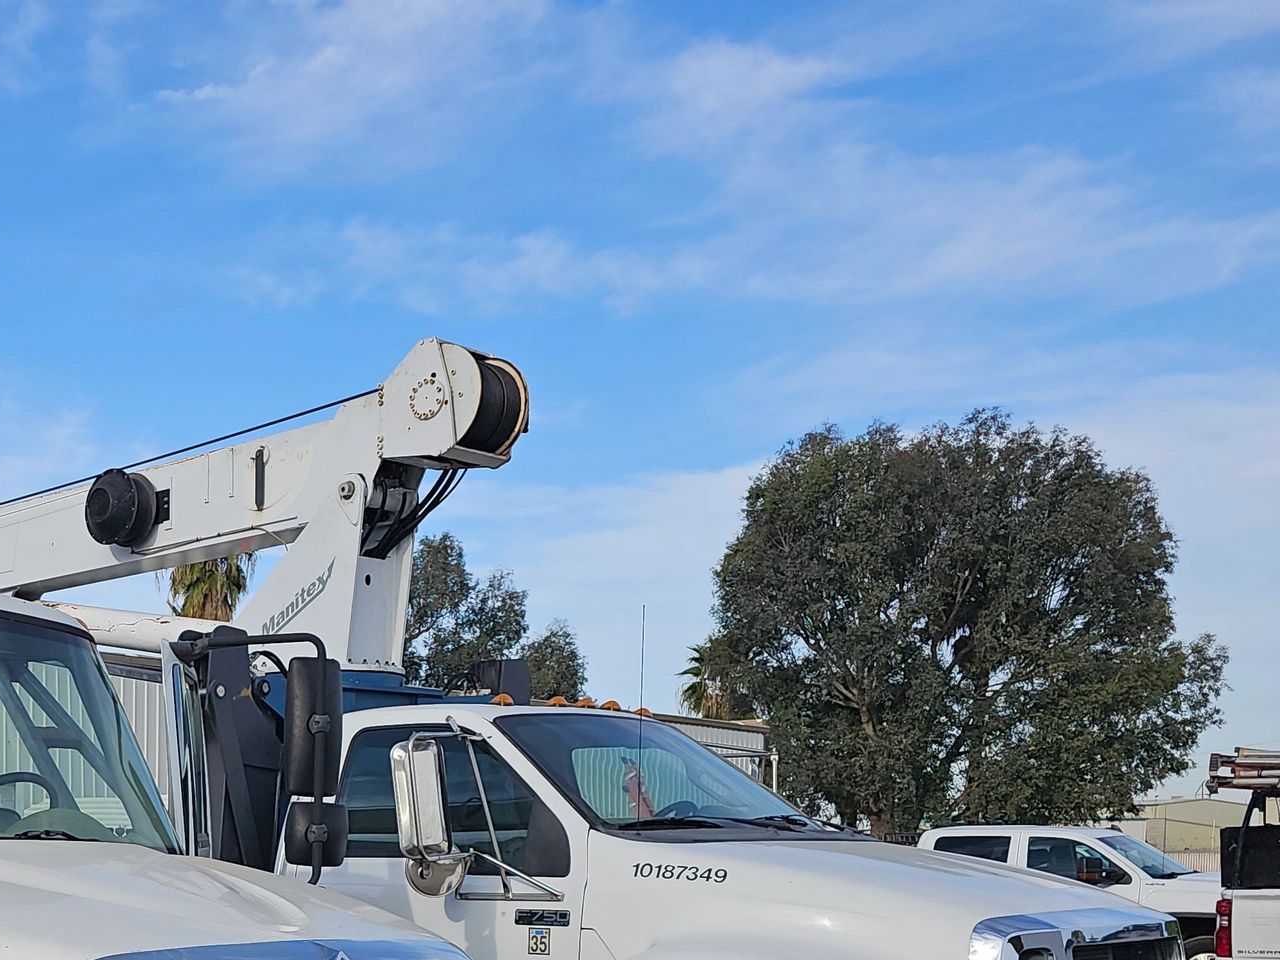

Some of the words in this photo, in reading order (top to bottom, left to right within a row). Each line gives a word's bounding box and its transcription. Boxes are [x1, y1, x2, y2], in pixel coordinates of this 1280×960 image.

[262, 560, 334, 634] Manitex
[632, 863, 728, 883] 10187349
[531, 935, 547, 952] 35
